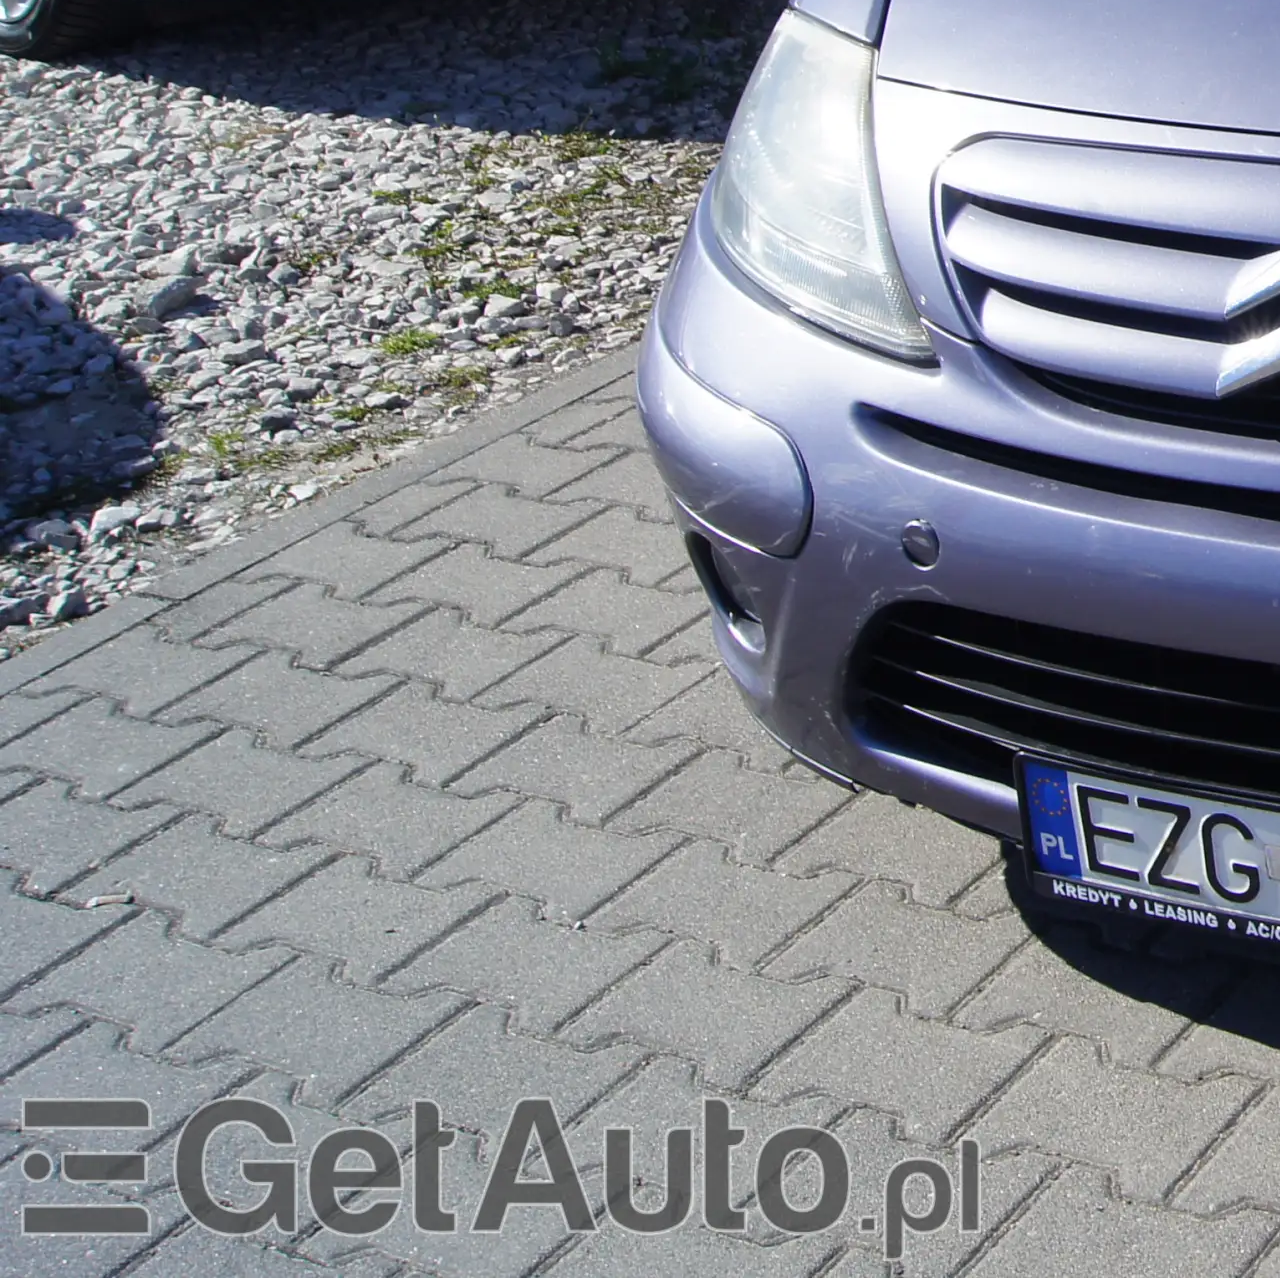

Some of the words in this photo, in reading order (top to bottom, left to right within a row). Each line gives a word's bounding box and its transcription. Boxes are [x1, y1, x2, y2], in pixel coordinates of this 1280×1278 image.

[1040, 832, 1073, 861] PL
[1076, 783, 1260, 903] EZG
[1053, 879, 1121, 908] KREDYT
[1144, 899, 1218, 928] LEASING
